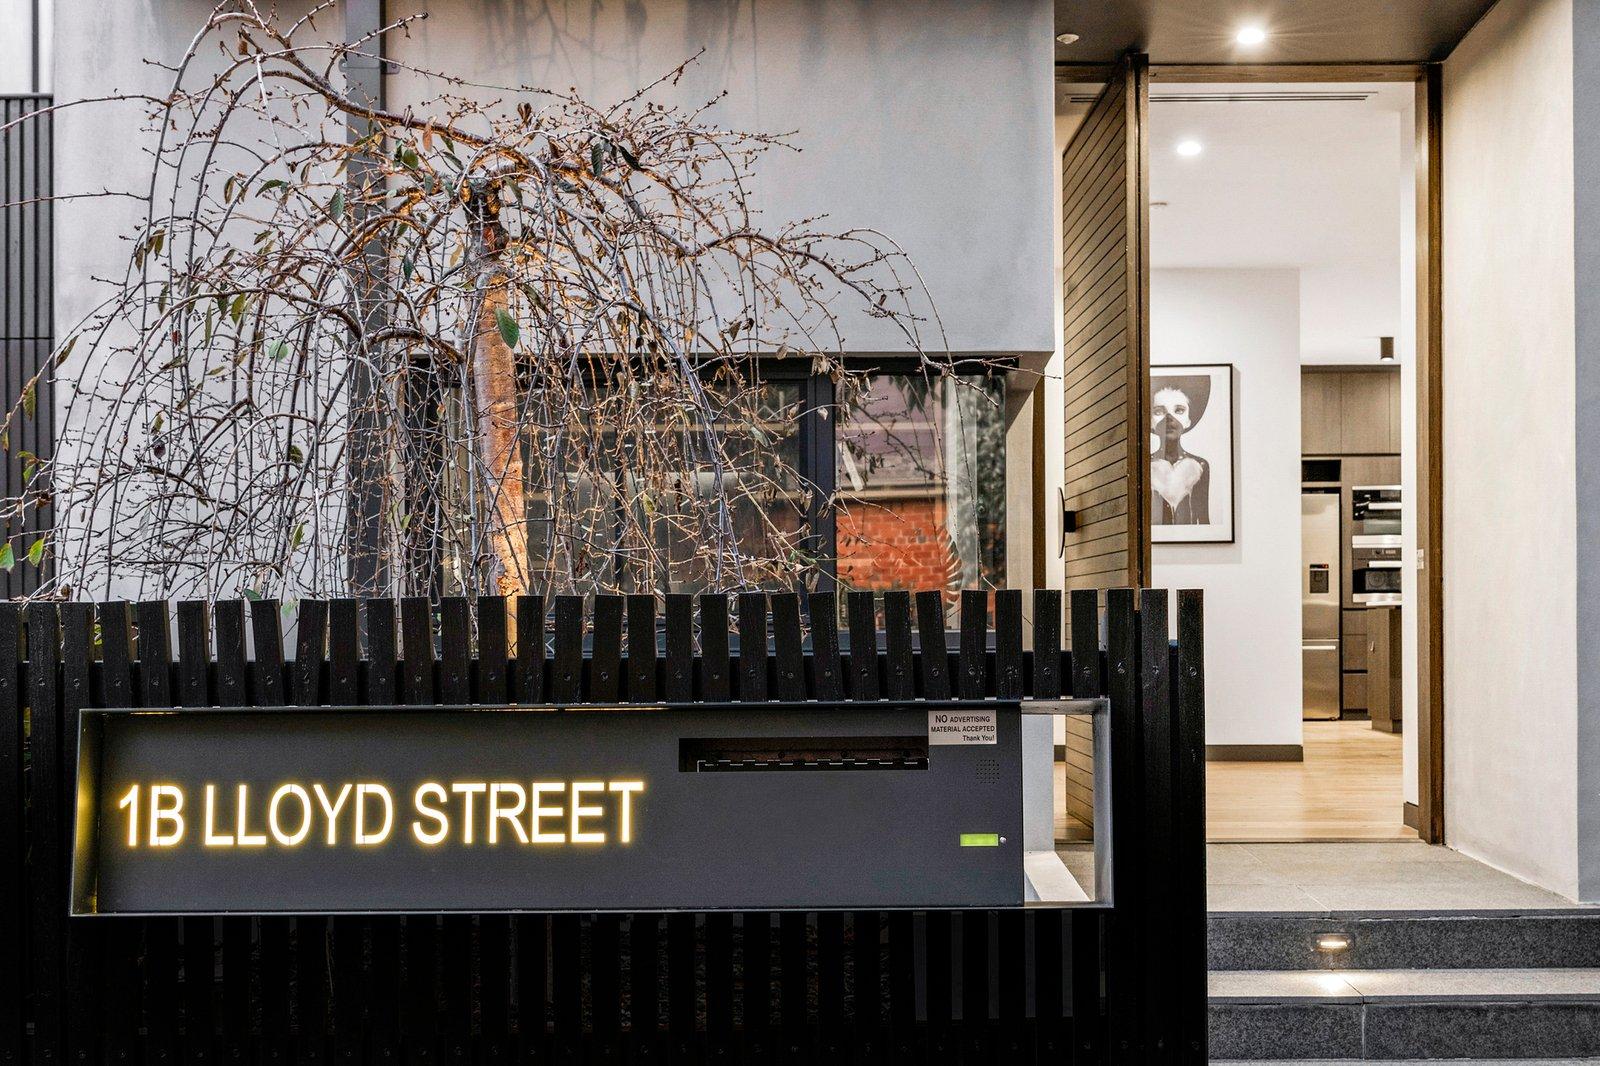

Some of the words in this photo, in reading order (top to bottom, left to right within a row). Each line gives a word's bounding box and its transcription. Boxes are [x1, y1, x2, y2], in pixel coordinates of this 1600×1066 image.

[935, 715, 948, 723] NO
[118, 783, 184, 847] 1B
[203, 783, 394, 846] LLOYD
[412, 781, 645, 845] STREET
